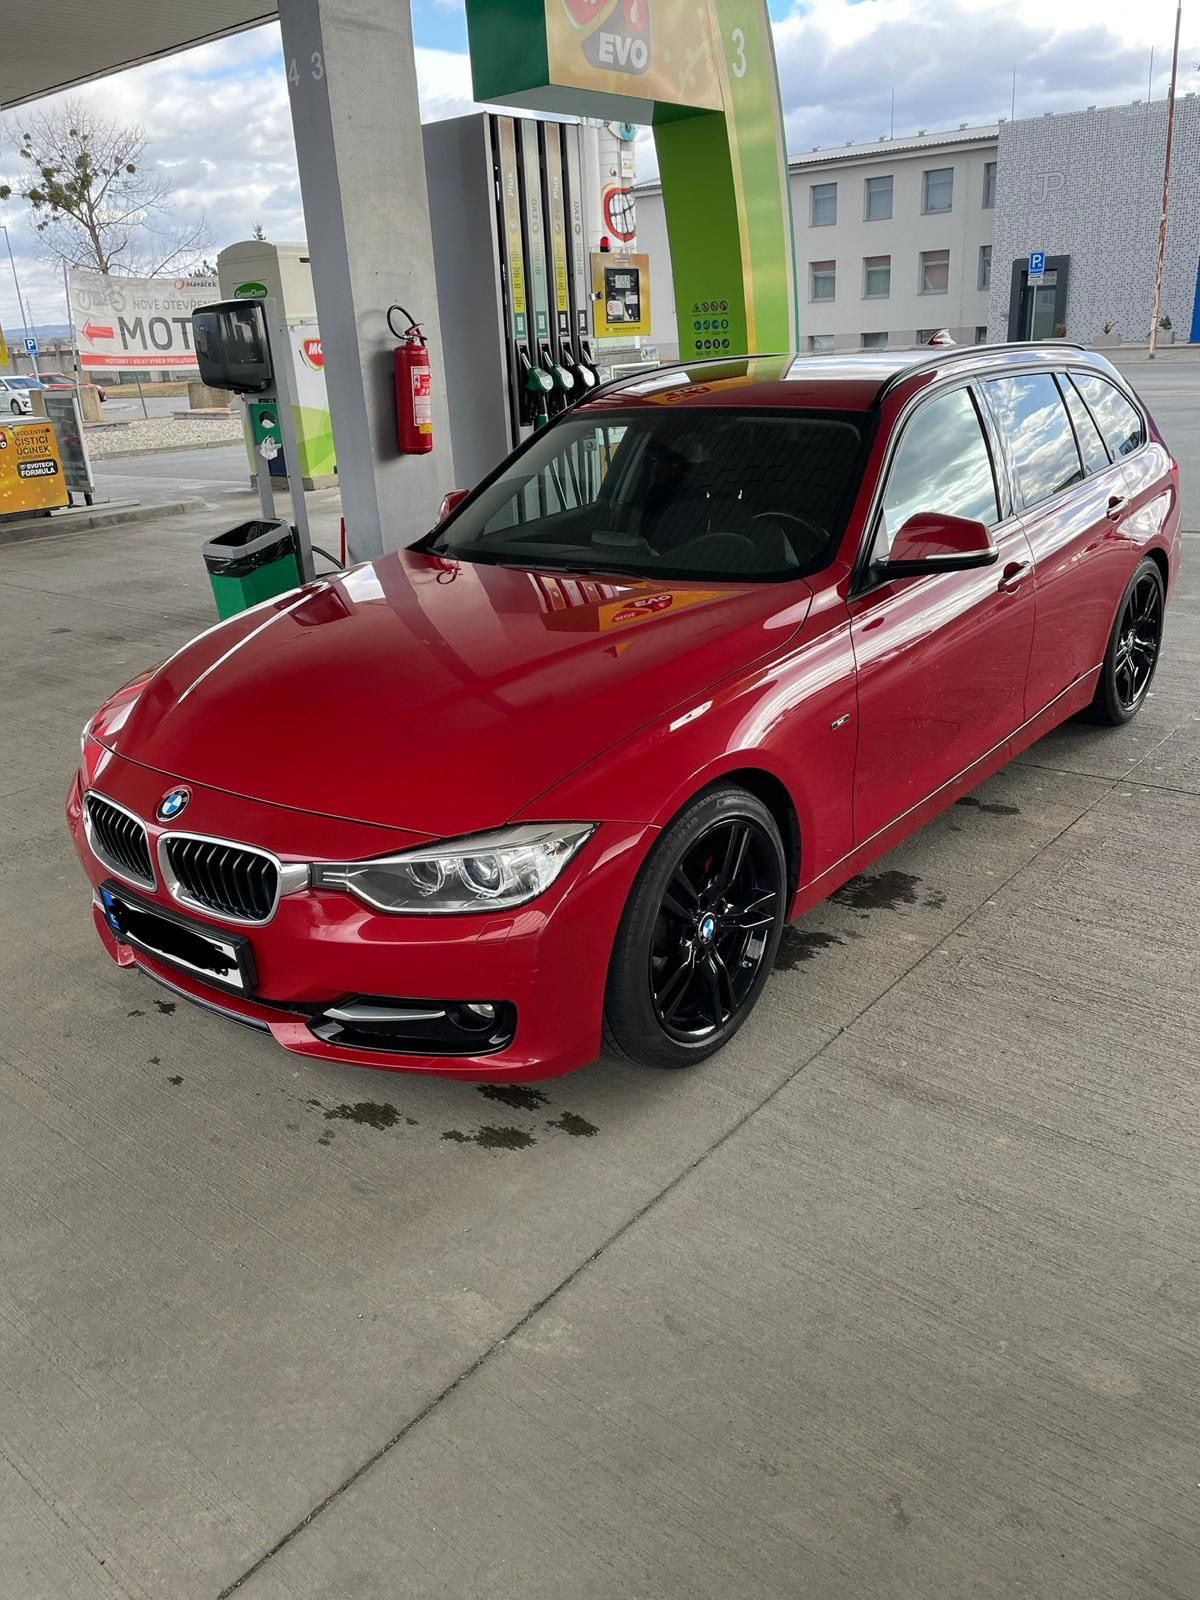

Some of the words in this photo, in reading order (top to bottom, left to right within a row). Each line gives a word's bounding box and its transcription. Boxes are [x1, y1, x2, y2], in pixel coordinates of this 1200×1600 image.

[288, 58, 300, 86] 4
[311, 51, 324, 80] 3
[599, 32, 648, 70] EVO
[731, 28, 747, 78] 3
[1032, 254, 1042, 268] P
[21, 467, 56, 477] FORMULA
